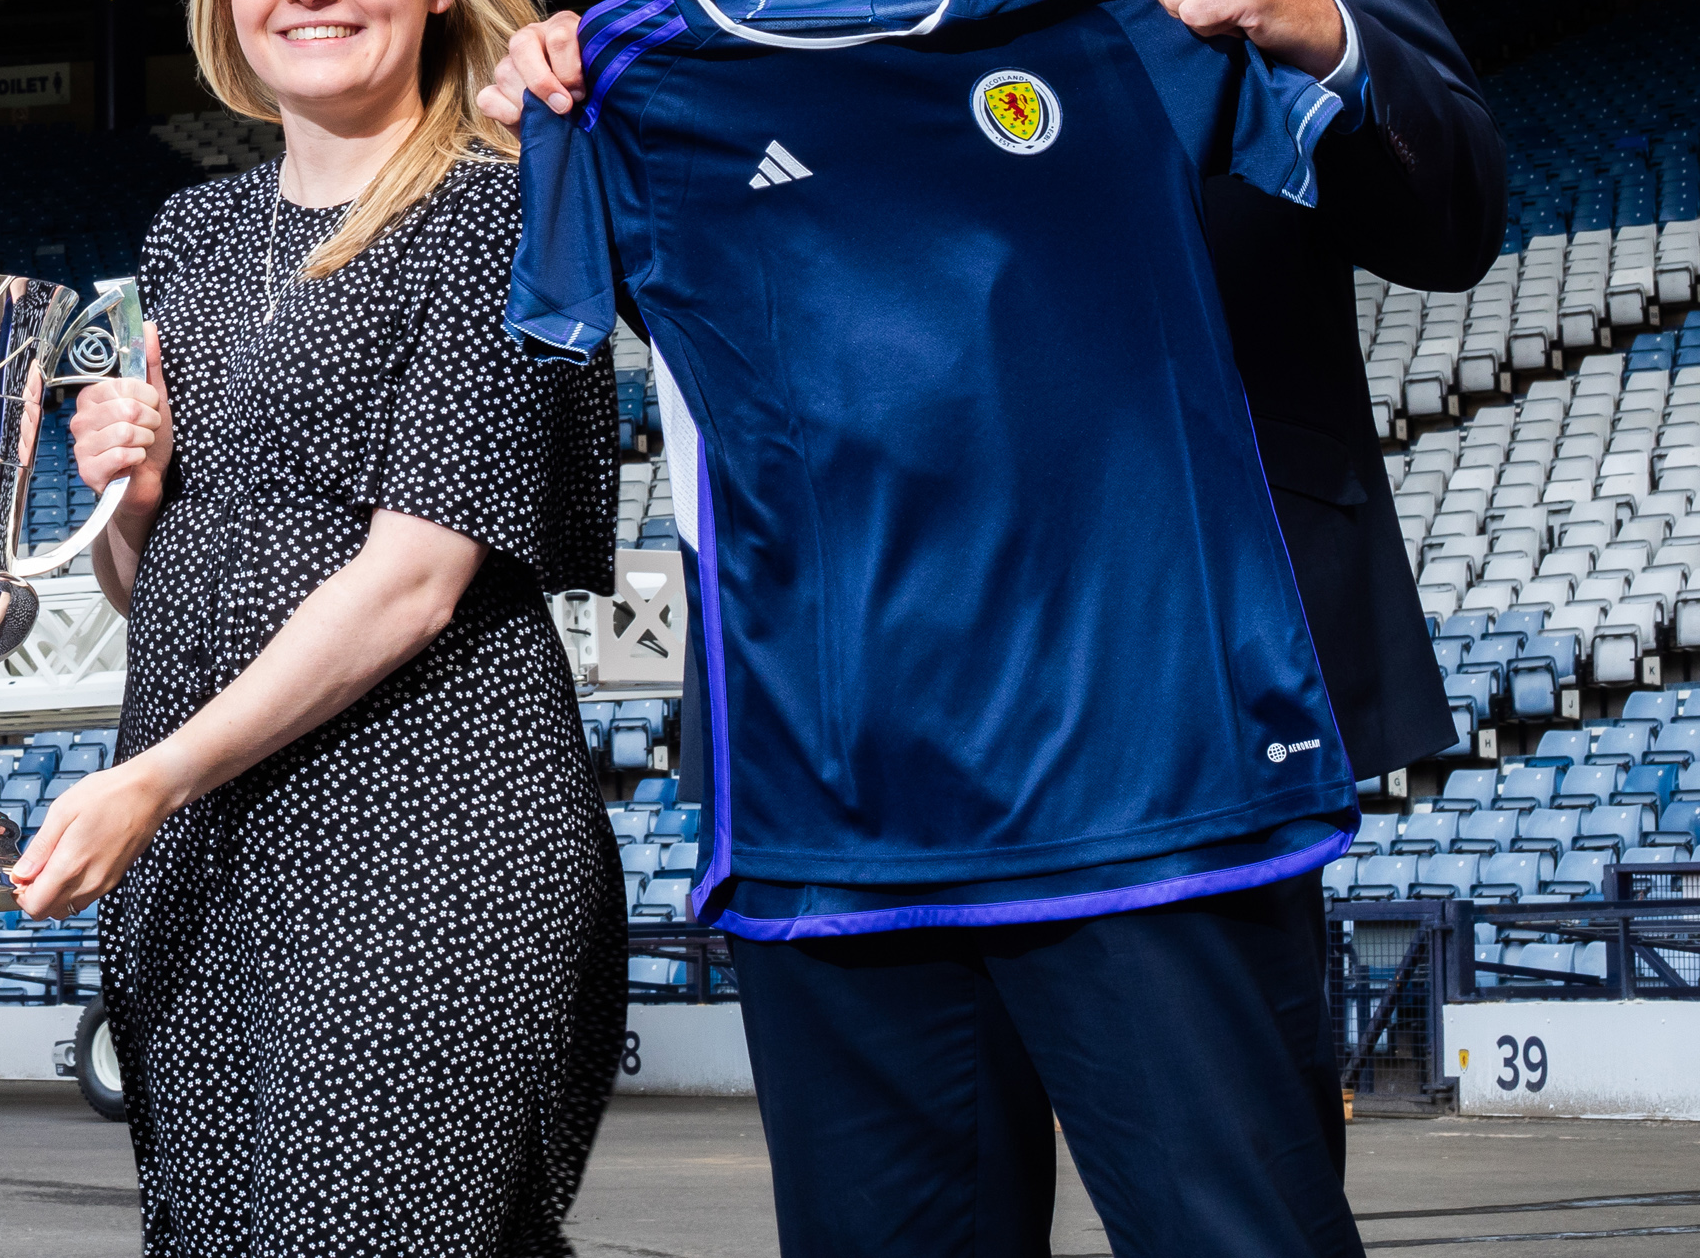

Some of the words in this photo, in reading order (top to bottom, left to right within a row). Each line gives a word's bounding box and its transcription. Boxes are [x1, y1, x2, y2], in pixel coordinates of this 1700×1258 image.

[985, 75, 1025, 90] SCOTLAND
[1042, 128, 1055, 142] 1873
[998, 137, 1012, 148] EST
[1495, 1034, 1548, 1093] 39
